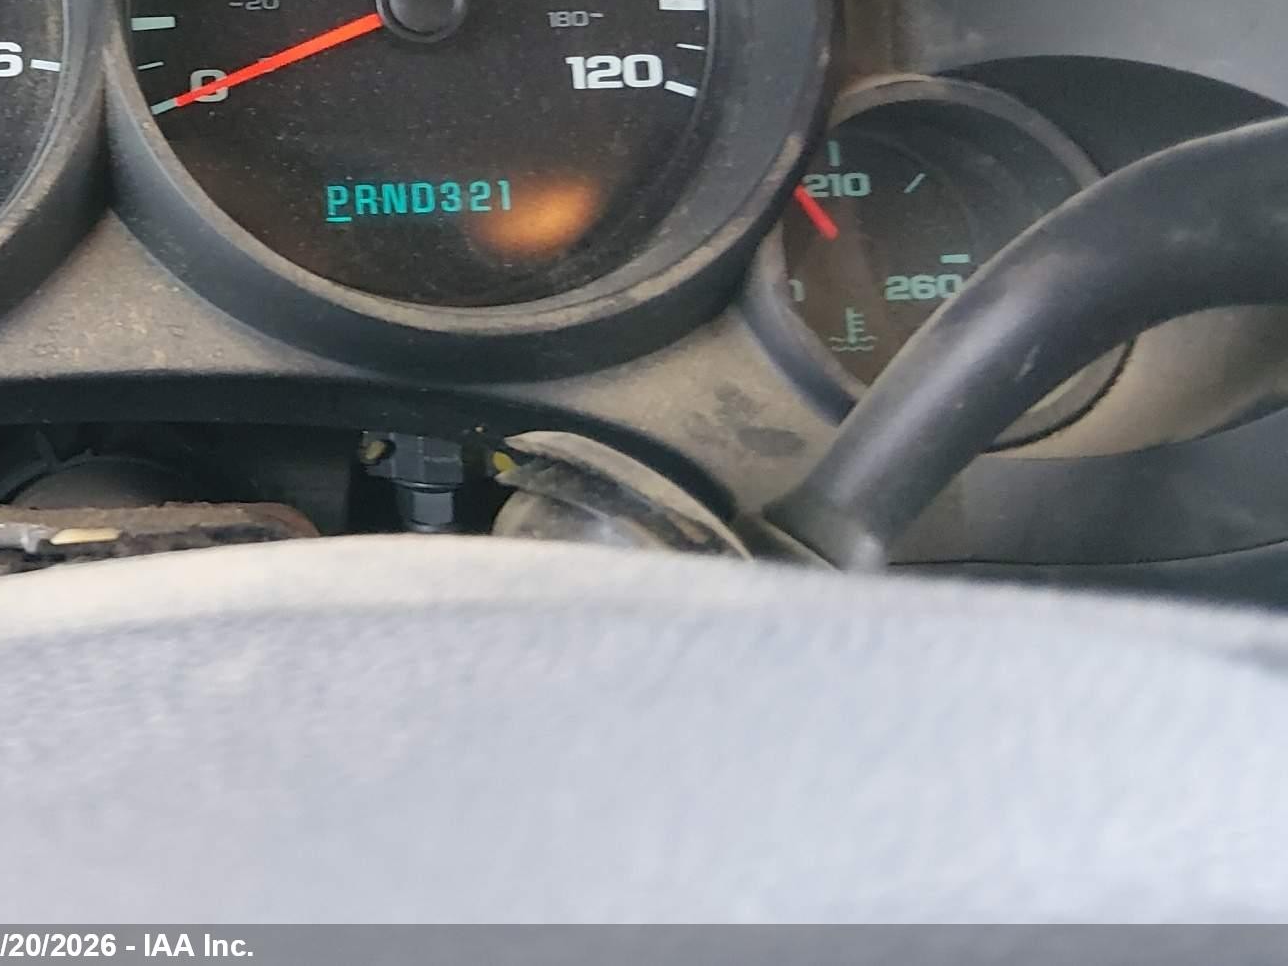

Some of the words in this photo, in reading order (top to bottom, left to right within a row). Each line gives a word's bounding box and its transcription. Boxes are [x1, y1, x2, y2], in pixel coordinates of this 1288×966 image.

[547, 10, 589, 28] 180
[564, 53, 664, 91] 120
[190, 69, 229, 103] 0
[802, 172, 871, 197] 210
[884, 274, 963, 301] 260
